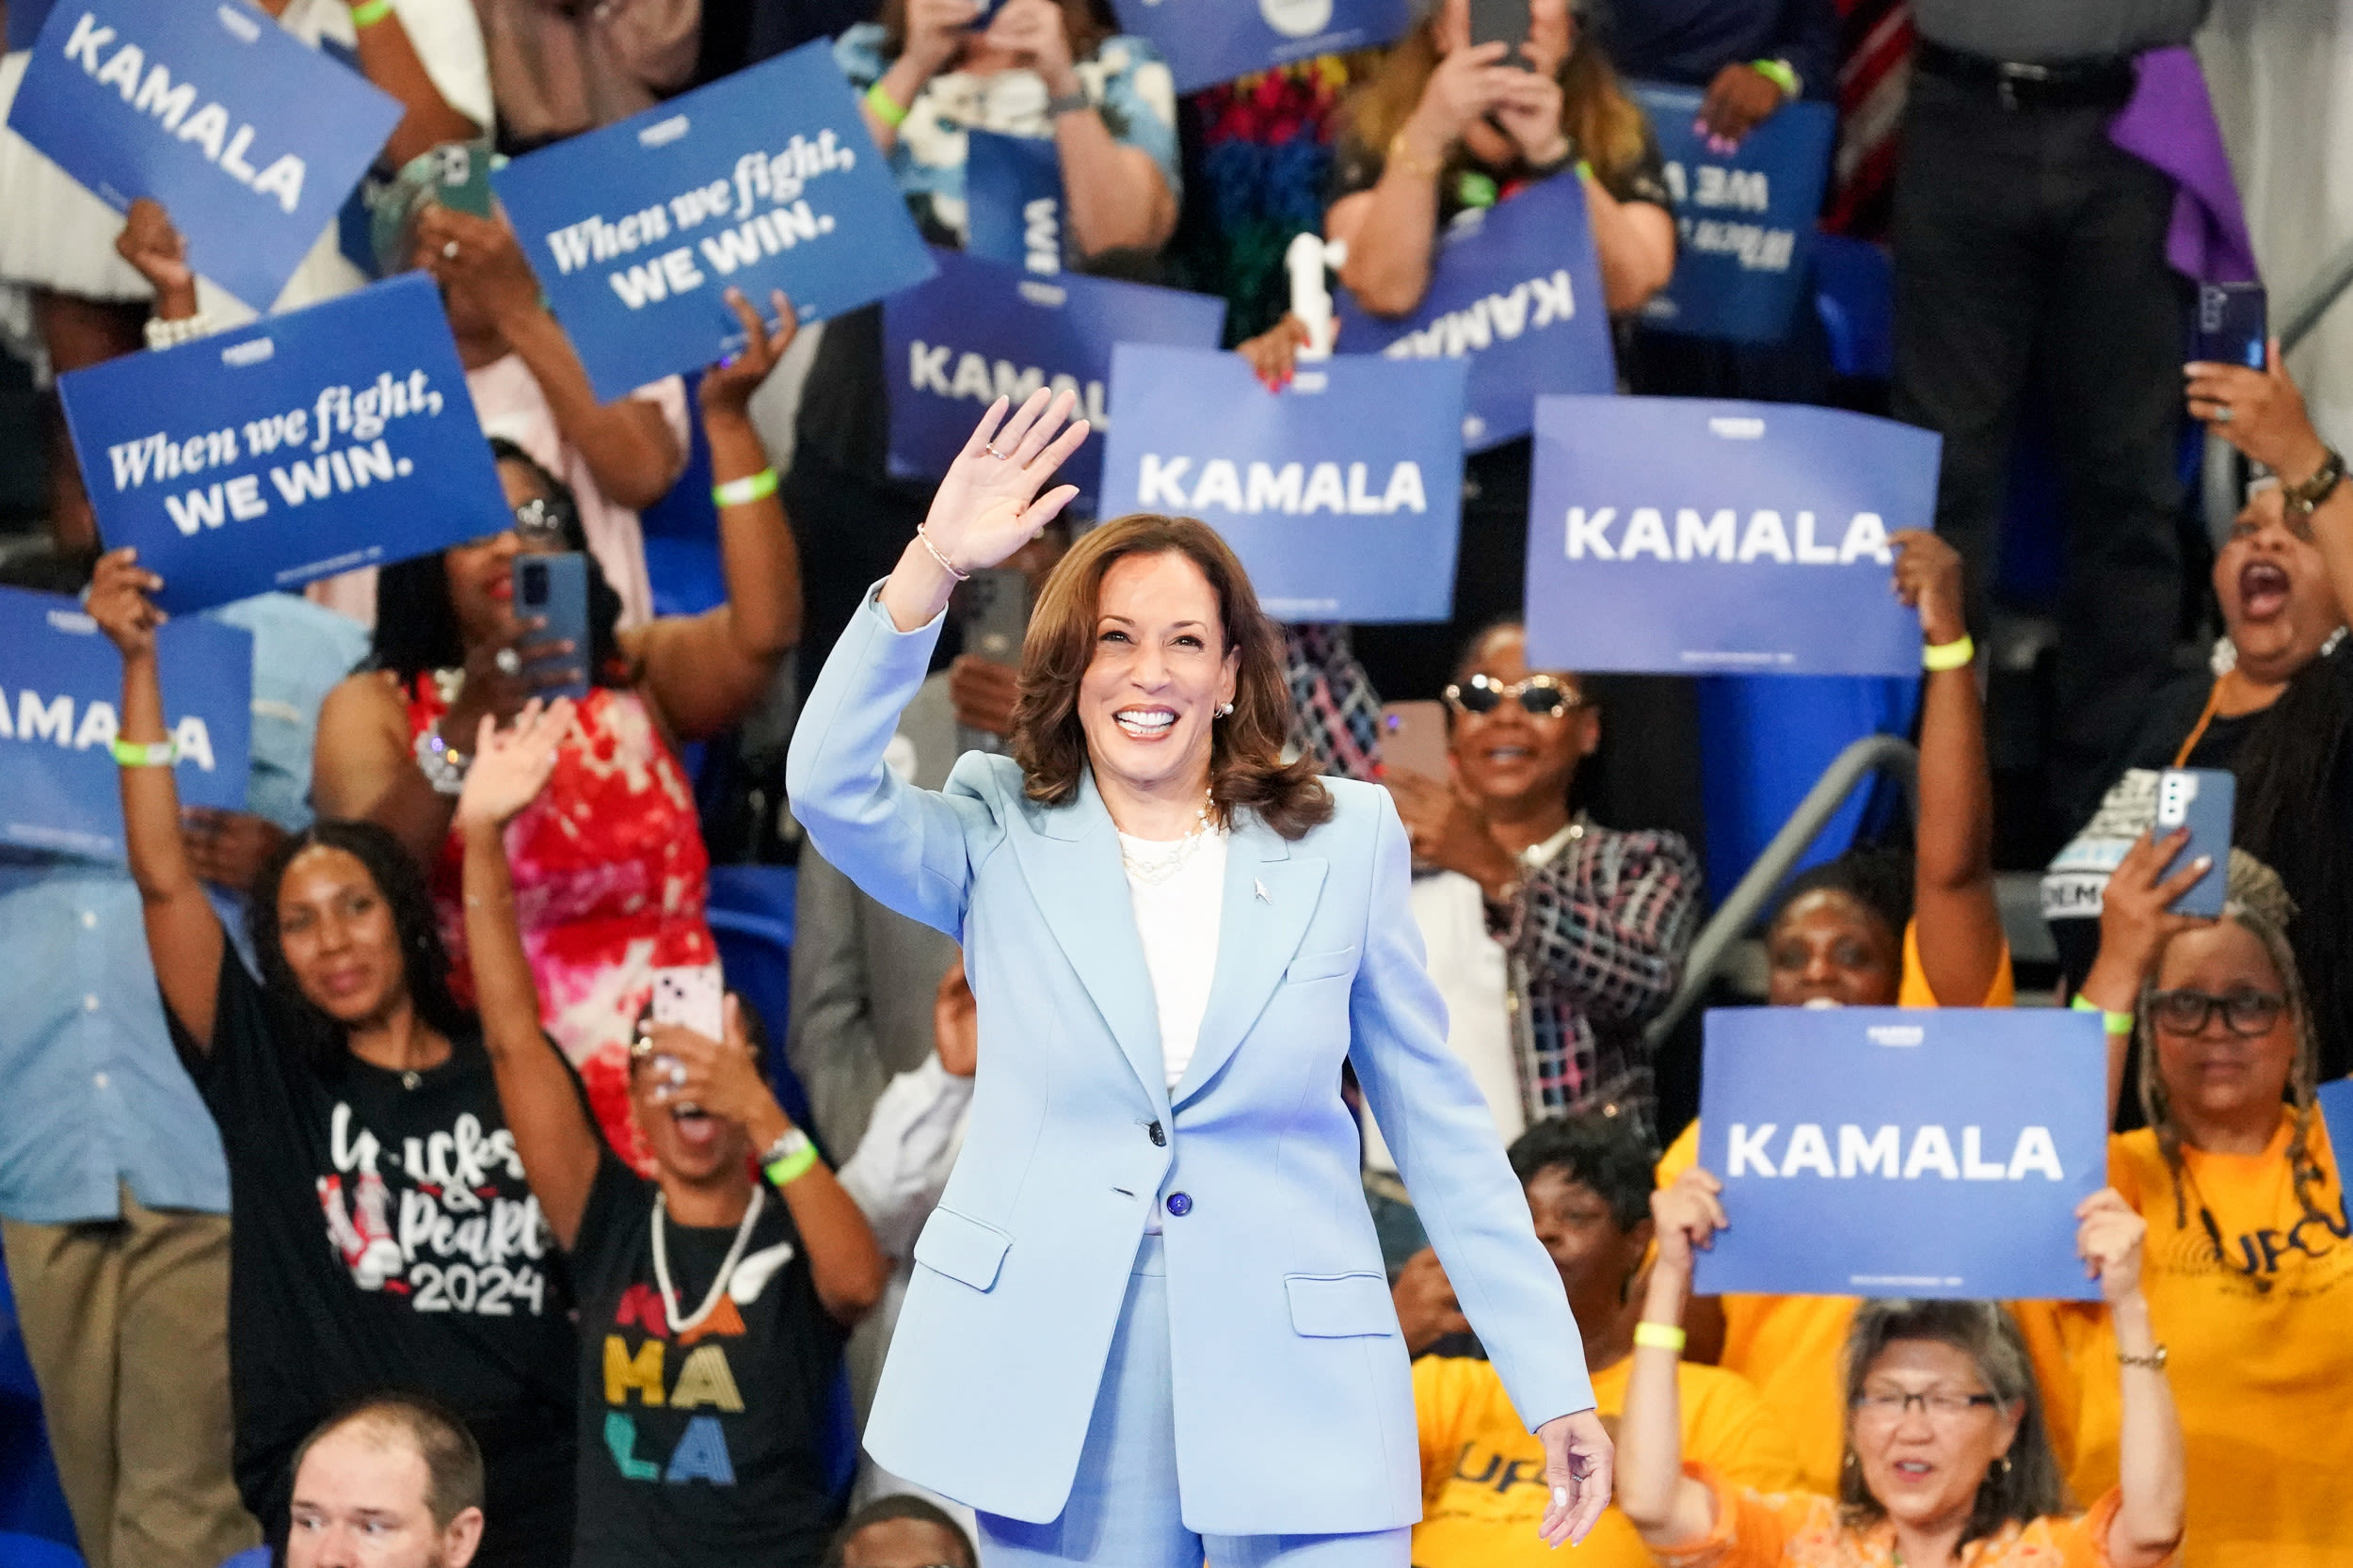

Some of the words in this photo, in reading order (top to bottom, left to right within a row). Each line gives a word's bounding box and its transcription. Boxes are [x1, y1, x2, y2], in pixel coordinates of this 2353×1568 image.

[64, 12, 306, 213] KAMALA
[547, 204, 669, 275] When
[670, 179, 731, 232] we
[732, 129, 856, 220] fight,
[609, 246, 705, 311] WE
[701, 200, 836, 277] WIN.
[108, 430, 238, 491] When
[242, 408, 307, 456] we
[309, 369, 443, 454] fight,
[165, 474, 268, 536] WE
[271, 440, 413, 506] WIN.
[1137, 453, 1428, 516] KAMALA
[1564, 506, 1894, 565] KAMALA
[0, 686, 216, 772] MAA
[1726, 1123, 2064, 1181] KAMALA
[409, 1263, 544, 1316] 2024
[603, 1335, 745, 1412] MA
[604, 1412, 738, 1486] LA
